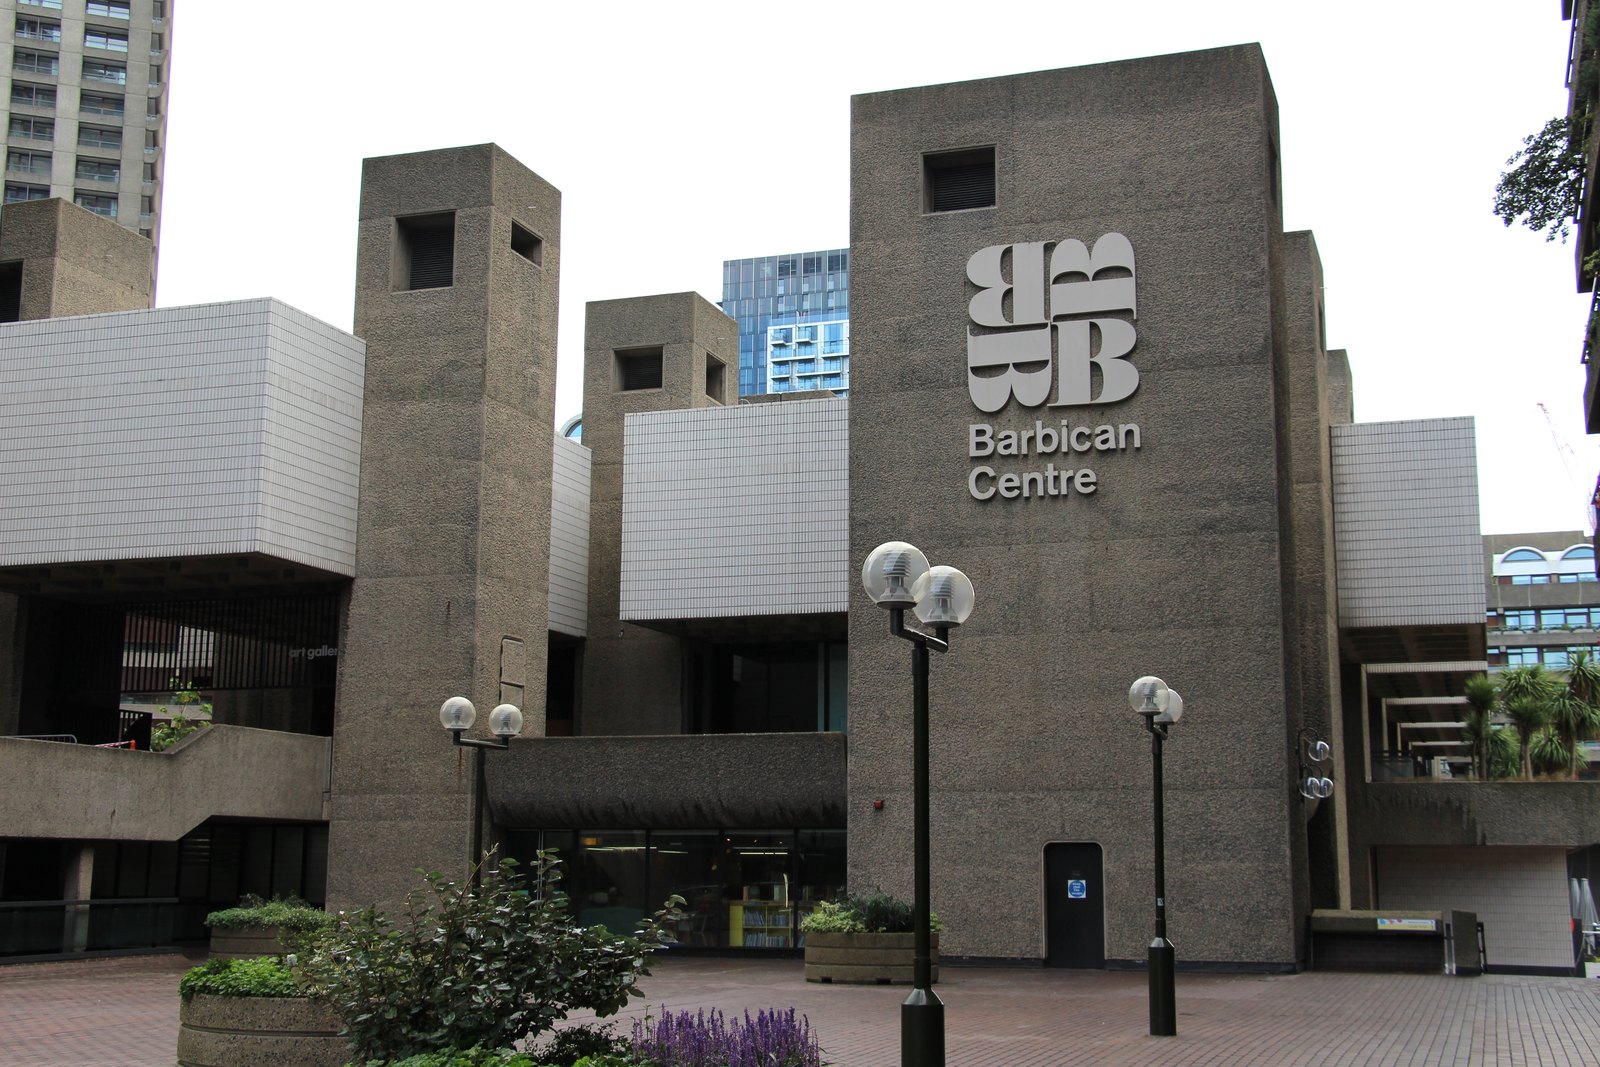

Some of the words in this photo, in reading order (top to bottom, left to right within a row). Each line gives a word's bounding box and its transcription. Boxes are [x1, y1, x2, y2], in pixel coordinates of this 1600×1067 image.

[968, 419, 1141, 457] Barbican
[968, 463, 1098, 500] Centre
[289, 648, 305, 657] art
